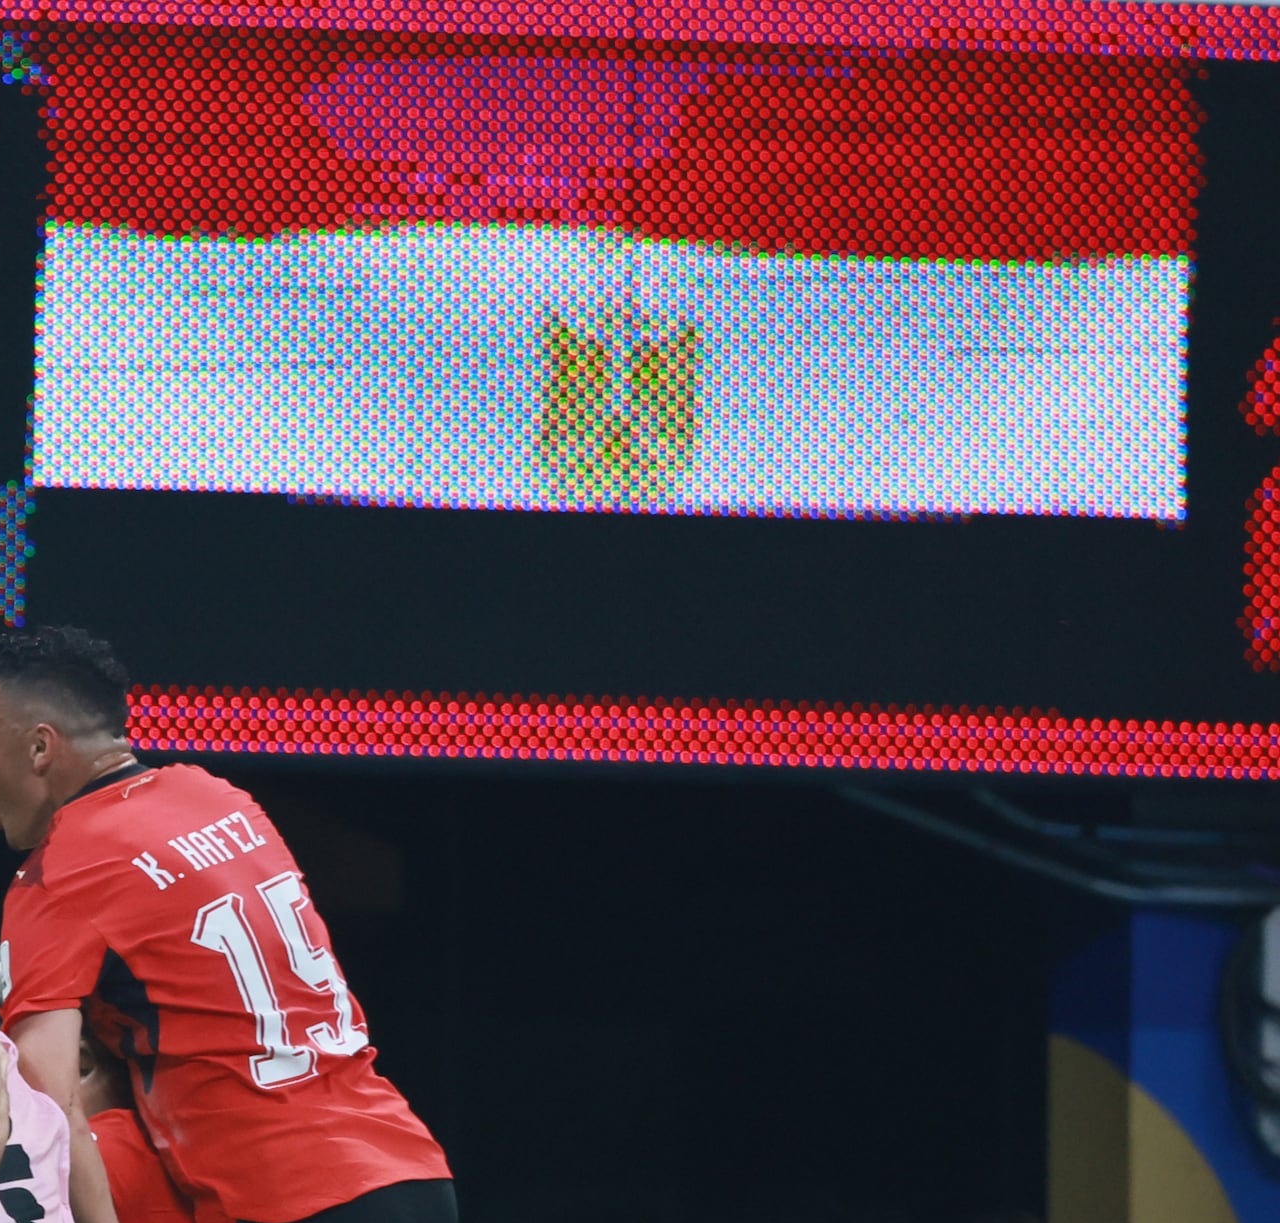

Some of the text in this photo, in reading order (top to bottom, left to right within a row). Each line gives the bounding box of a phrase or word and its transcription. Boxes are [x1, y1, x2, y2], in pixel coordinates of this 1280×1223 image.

[131, 811, 267, 891] K. HAFEZ
[190, 871, 370, 1089] 15
